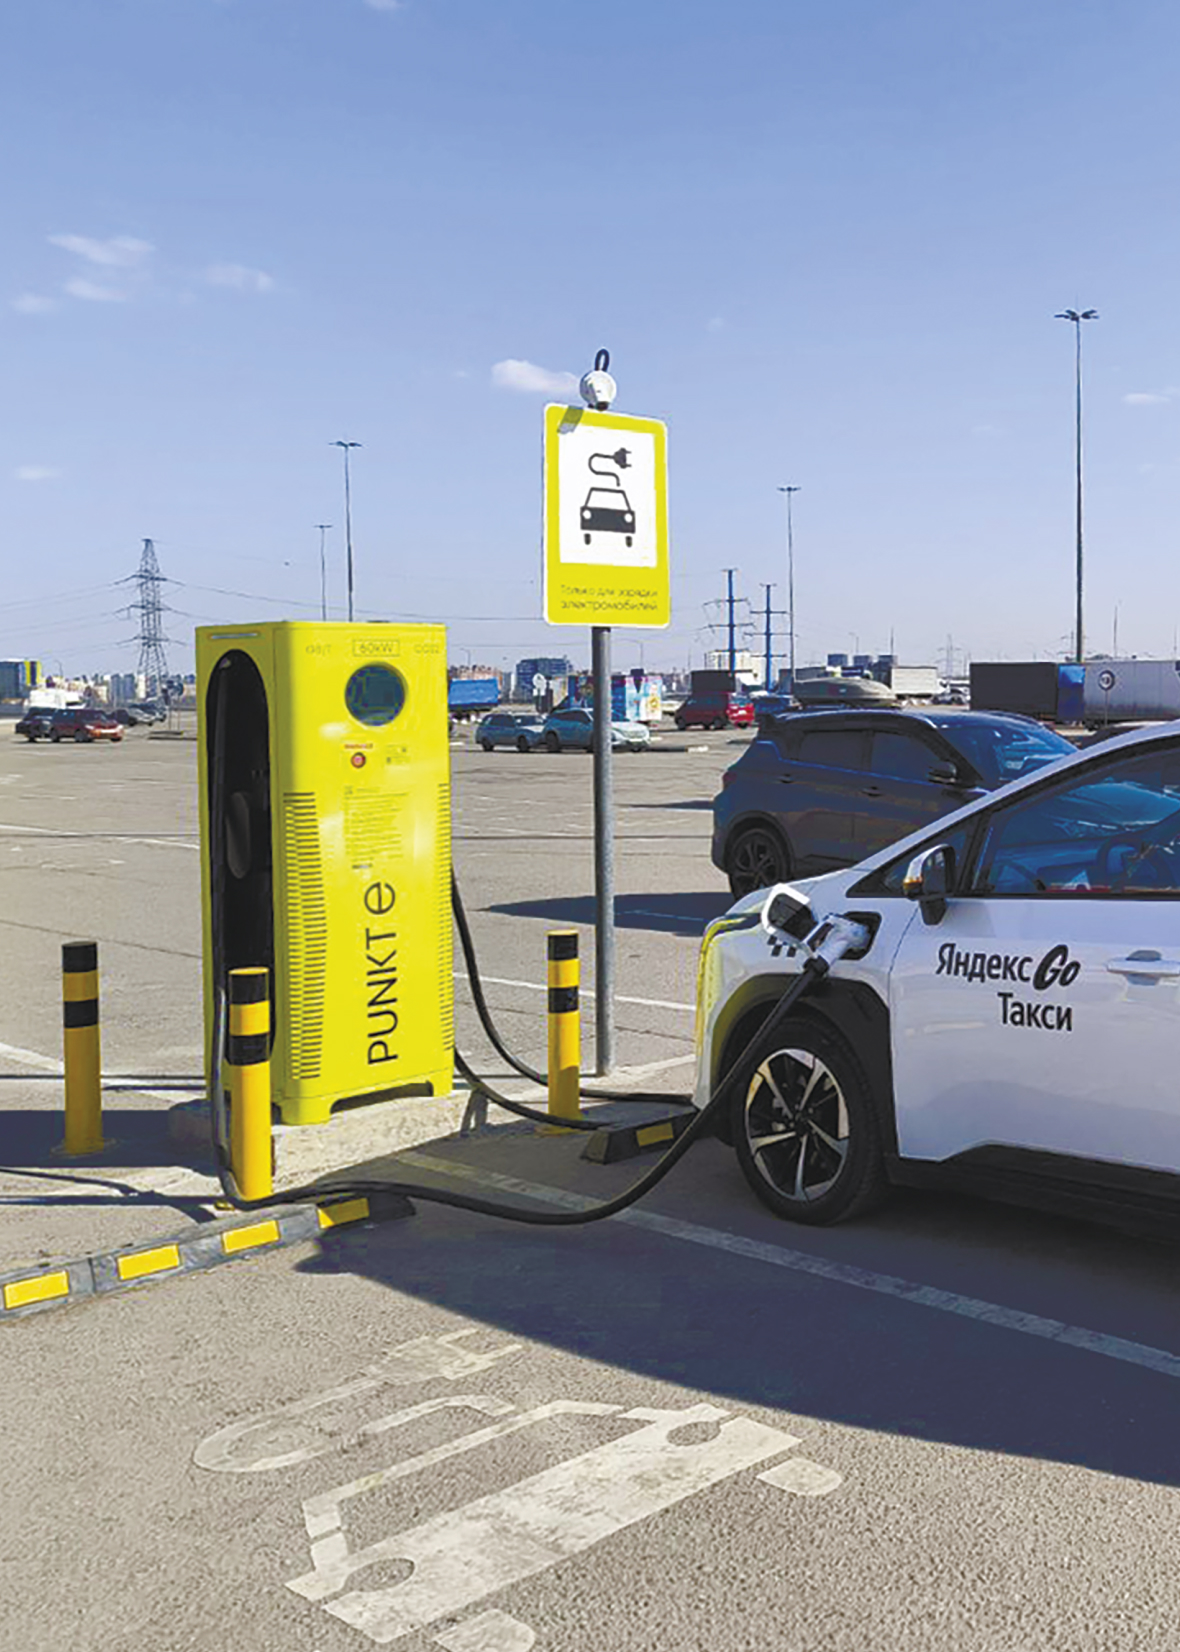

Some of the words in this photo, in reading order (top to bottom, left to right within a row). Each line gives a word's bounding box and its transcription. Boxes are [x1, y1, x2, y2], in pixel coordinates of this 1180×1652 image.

[936, 942, 1033, 983] Яндекс
[1032, 944, 1081, 990] Go
[997, 992, 1073, 1032] Такси
